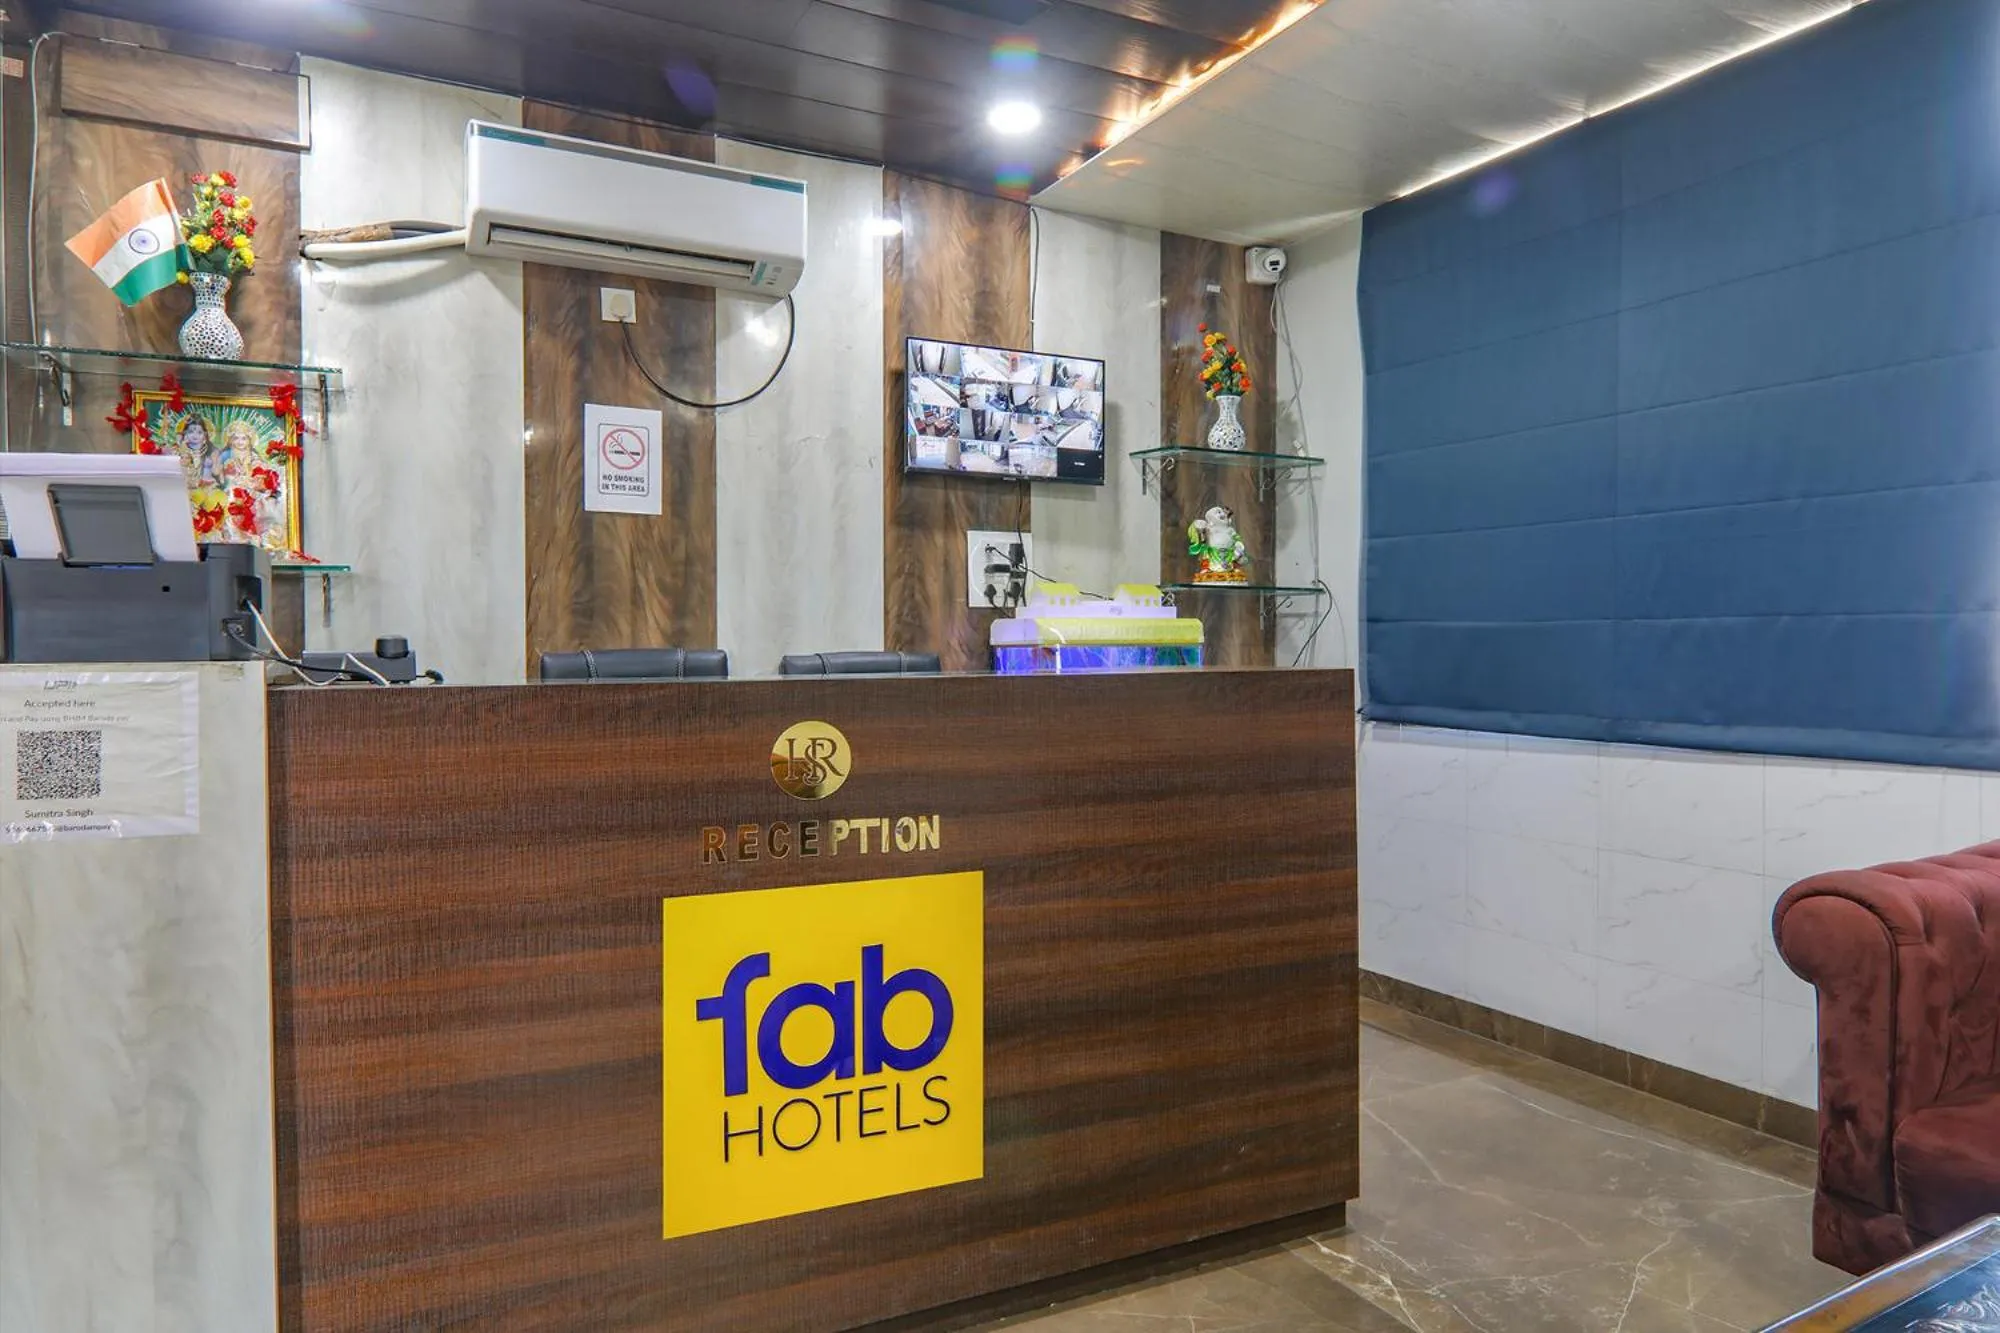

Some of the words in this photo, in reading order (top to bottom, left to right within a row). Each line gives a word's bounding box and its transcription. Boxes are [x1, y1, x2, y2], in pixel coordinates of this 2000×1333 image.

[602, 474, 612, 482] NO
[614, 475, 645, 483] SMOKING
[24, 699, 70, 709] Accepted
[73, 699, 96, 708] here
[24, 809, 64, 818] Sumitra
[66, 808, 94, 818] Singh
[702, 814, 940, 865] RECEPTION
[696, 943, 954, 1097] fab
[724, 1075, 951, 1163] HOTELS
